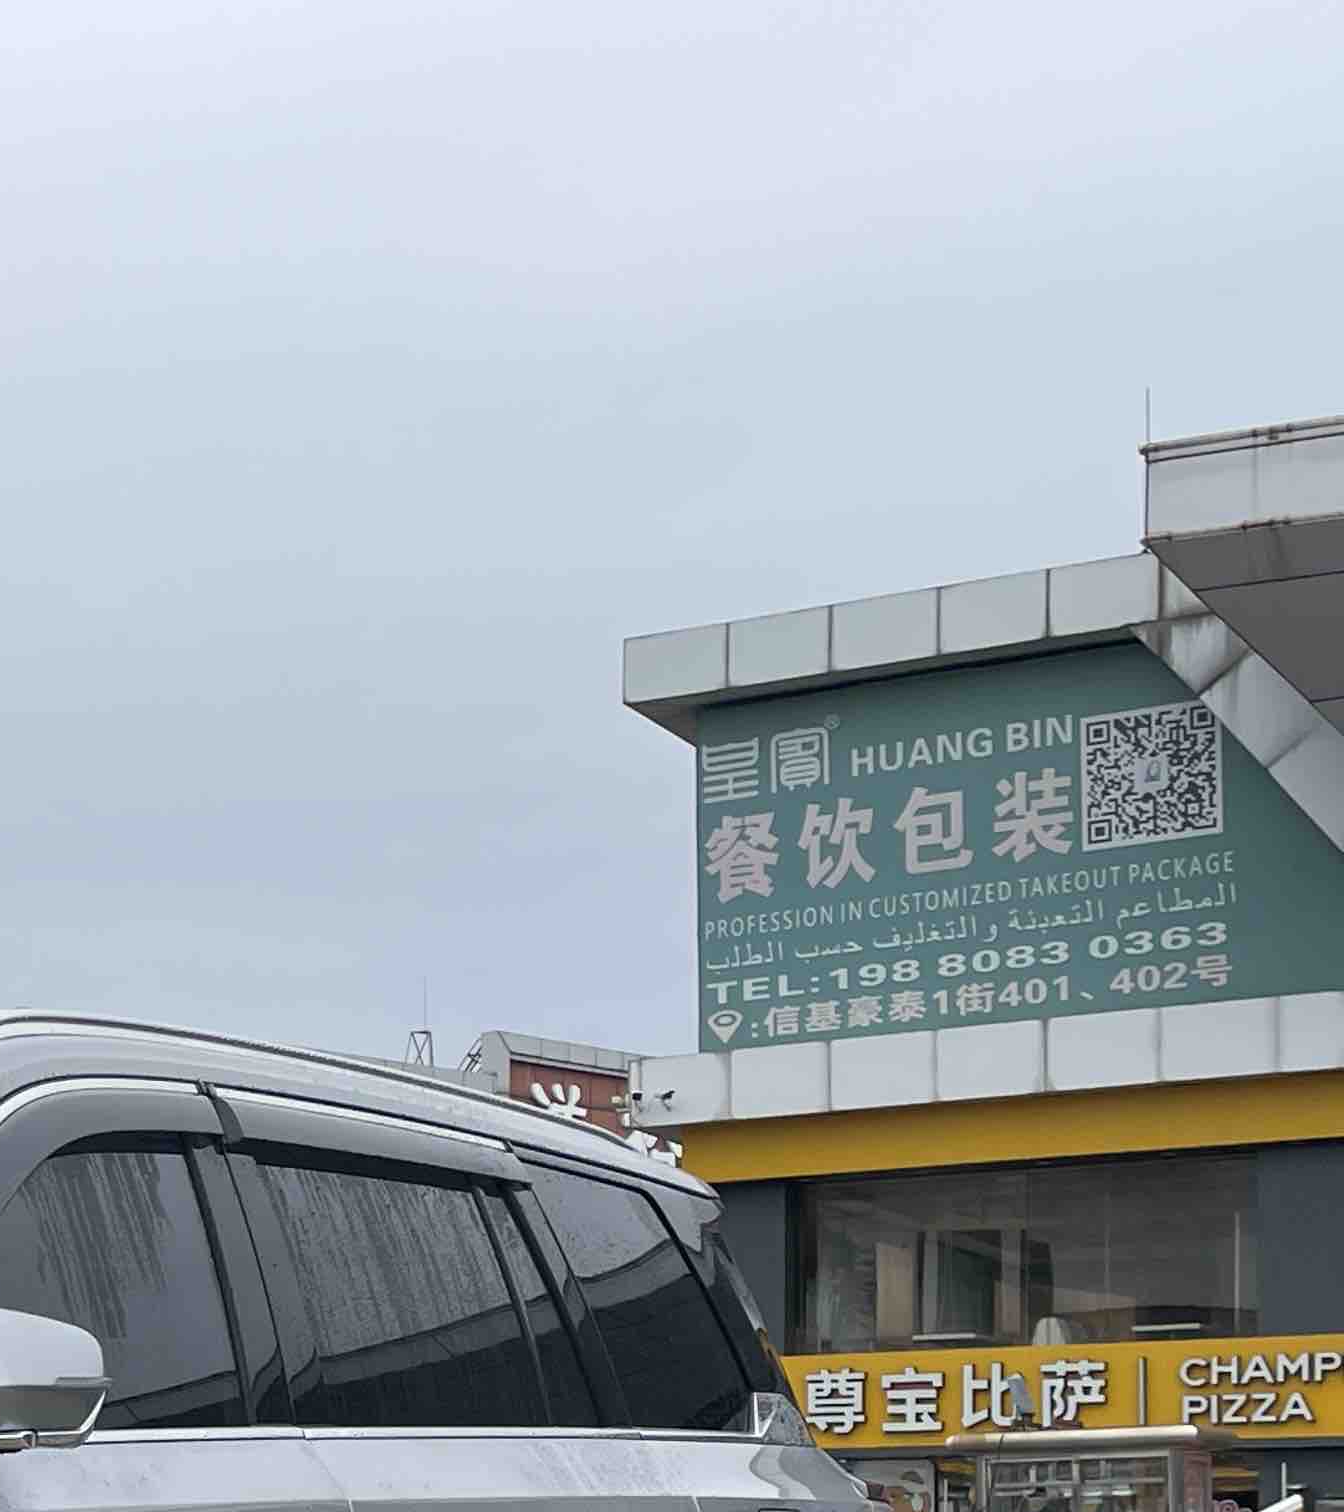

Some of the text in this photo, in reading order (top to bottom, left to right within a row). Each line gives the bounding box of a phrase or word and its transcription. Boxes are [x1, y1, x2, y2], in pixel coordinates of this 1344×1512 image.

[850, 714, 1073, 777] HUANG BIN
[704, 767, 1074, 904] 餐饮包装
[704, 850, 1236, 940] PROFESSION IN CUSTOMIZED TAKEOUT PACKAGE
[706, 921, 1228, 1004] TEL:198 8083 0363
[805, 1359, 1108, 1436] 尊宝比萨
[1179, 1352, 1344, 1388] CHAMP
[1181, 1391, 1315, 1425] PIZZA
